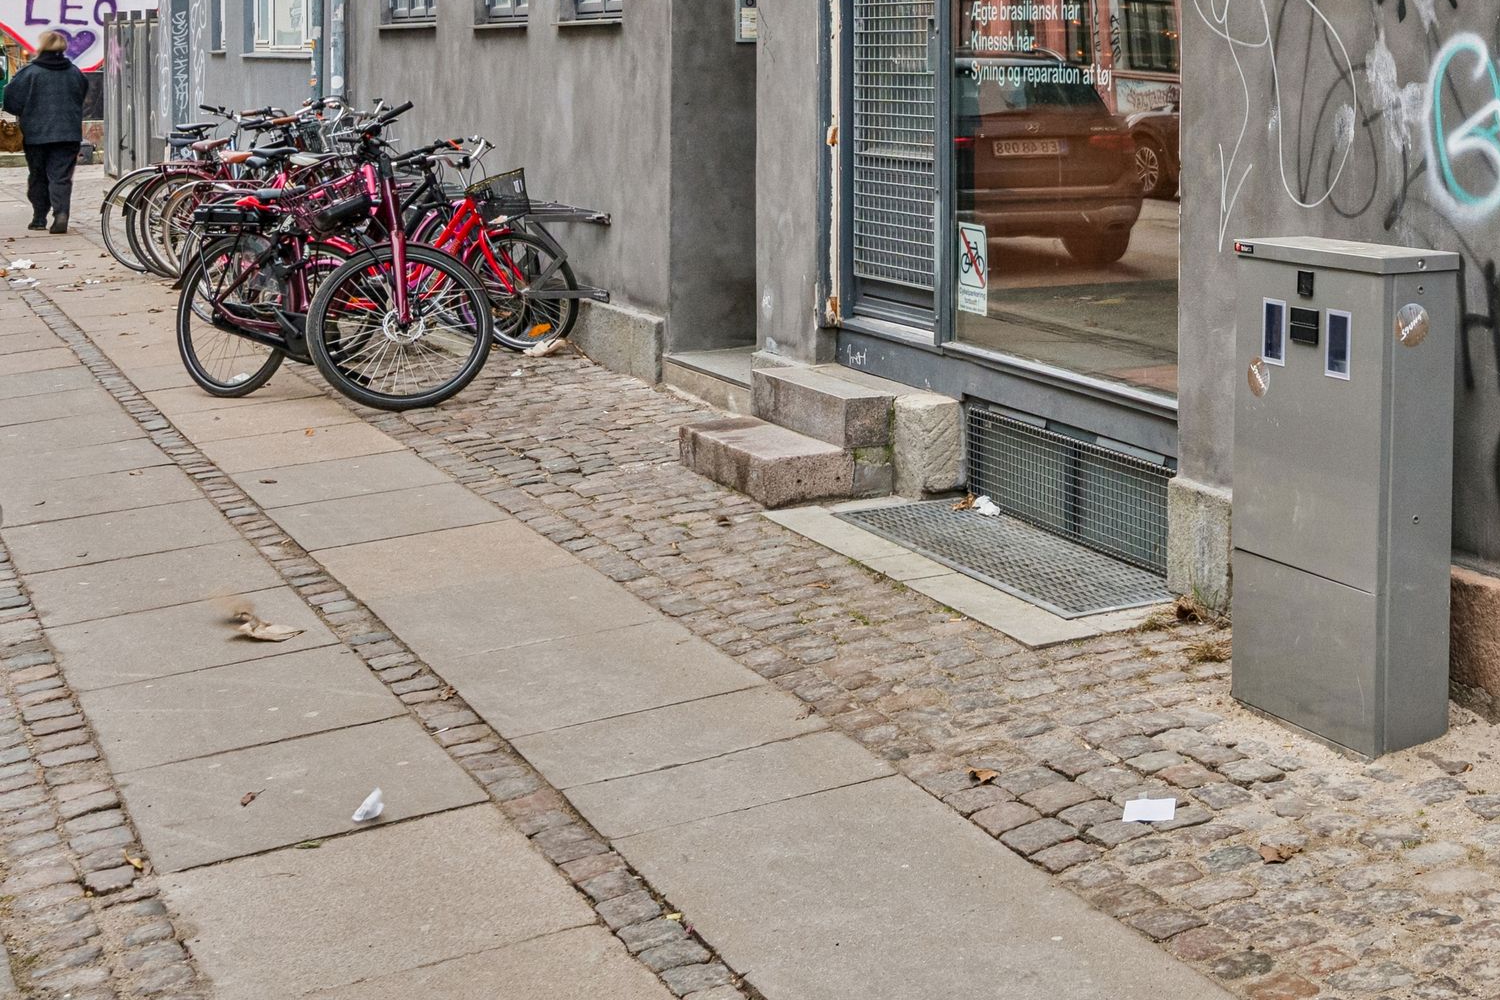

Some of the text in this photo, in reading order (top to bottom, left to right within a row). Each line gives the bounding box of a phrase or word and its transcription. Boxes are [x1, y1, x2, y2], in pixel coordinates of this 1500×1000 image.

[971, 1, 997, 25] Ægte
[971, 30, 1035, 51] Kinesisk hår
[971, 61, 1112, 91] Syning og reparation af tøj
